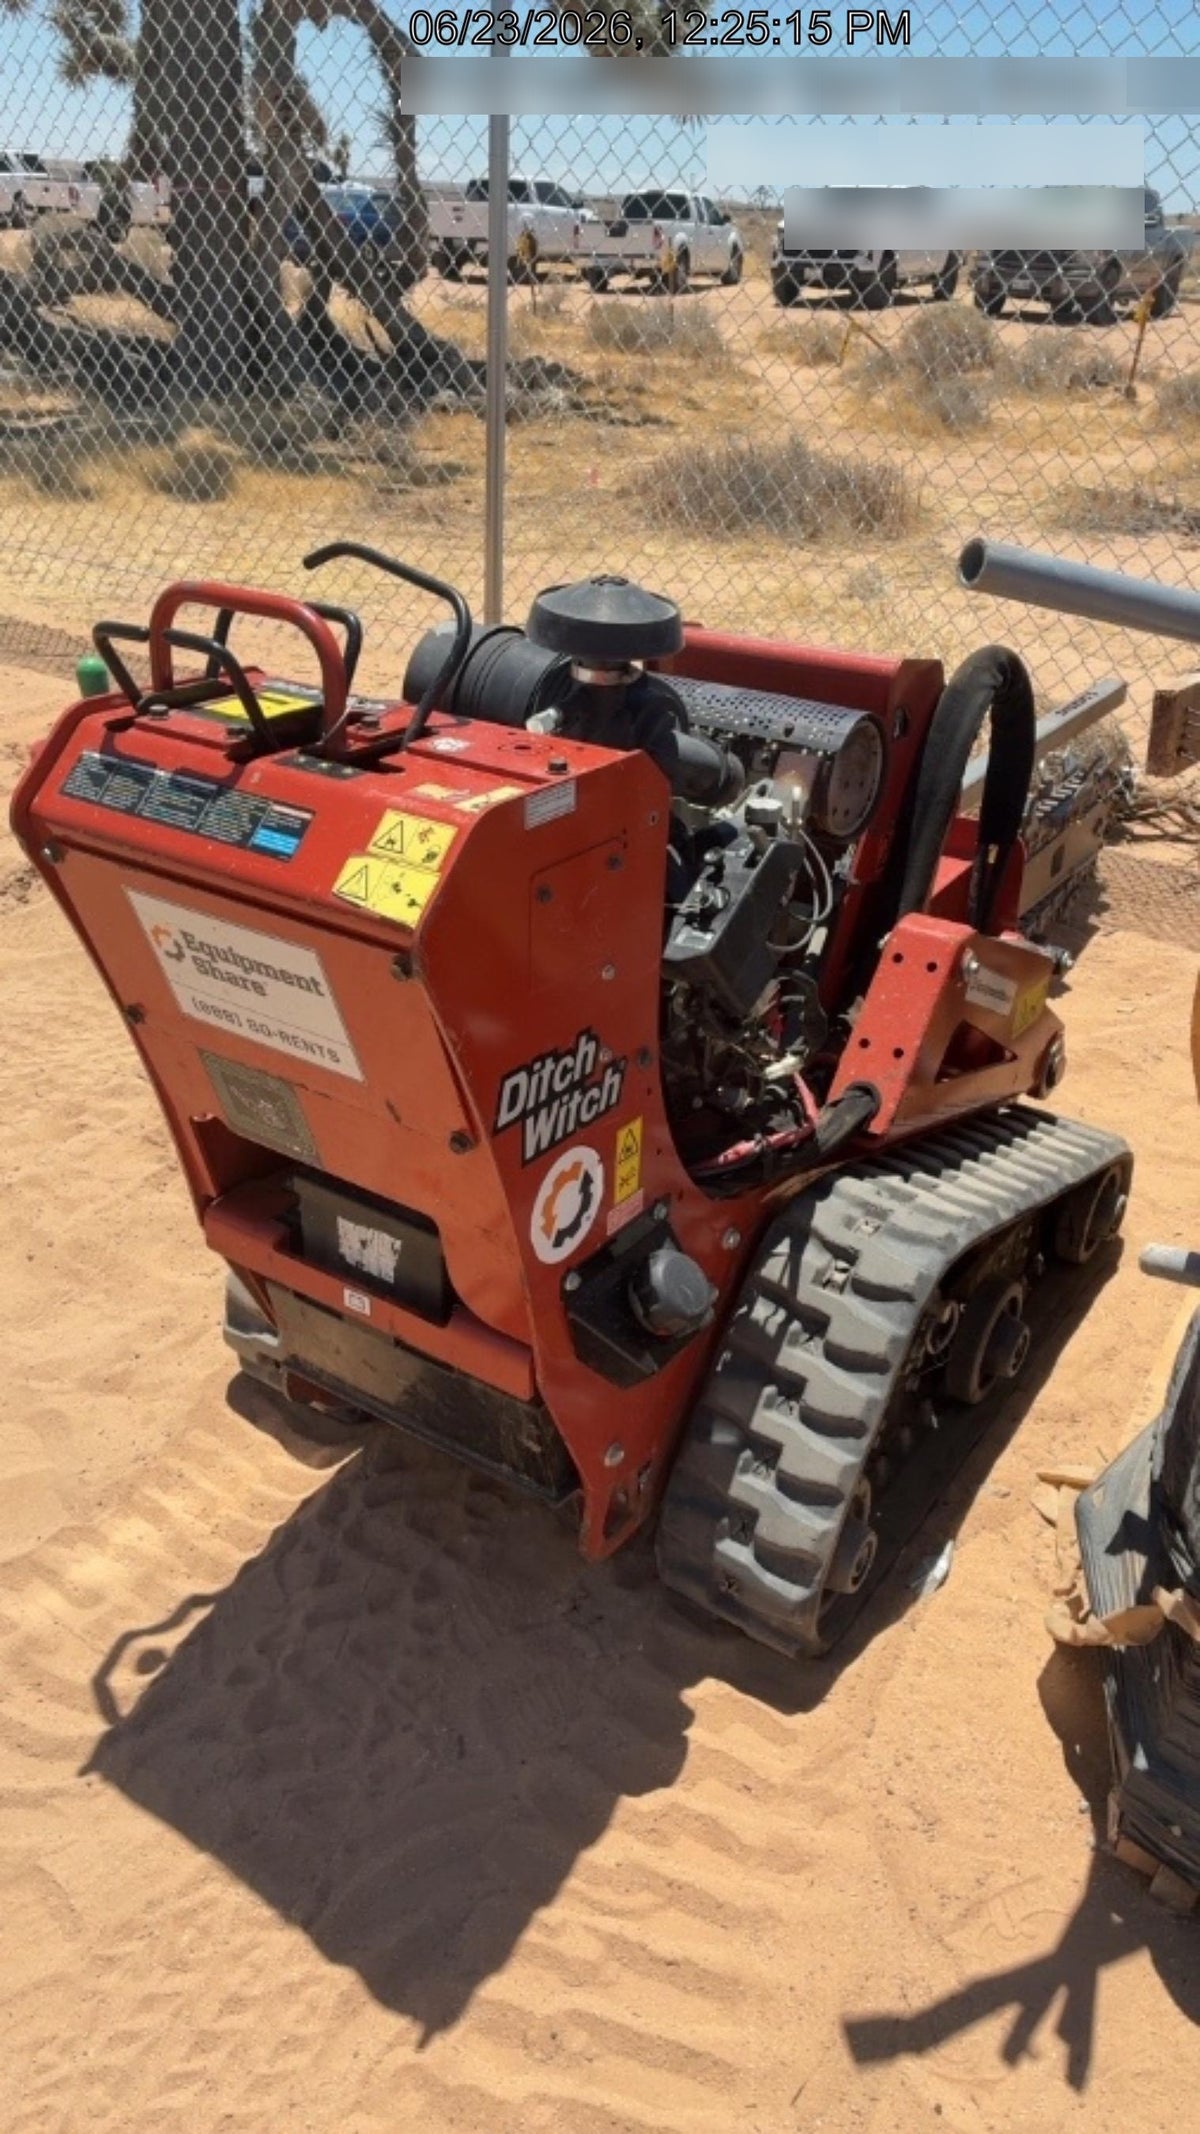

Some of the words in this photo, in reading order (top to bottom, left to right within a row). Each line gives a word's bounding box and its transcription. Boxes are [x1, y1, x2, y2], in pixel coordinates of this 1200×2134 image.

[180, 929, 325, 997] Equipment
[192, 955, 268, 997] Share
[191, 996, 242, 1028] (888)
[246, 1017, 340, 1064] 80-RENTS
[495, 1031, 598, 1130] Ditch
[523, 1064, 623, 1161] Witch
